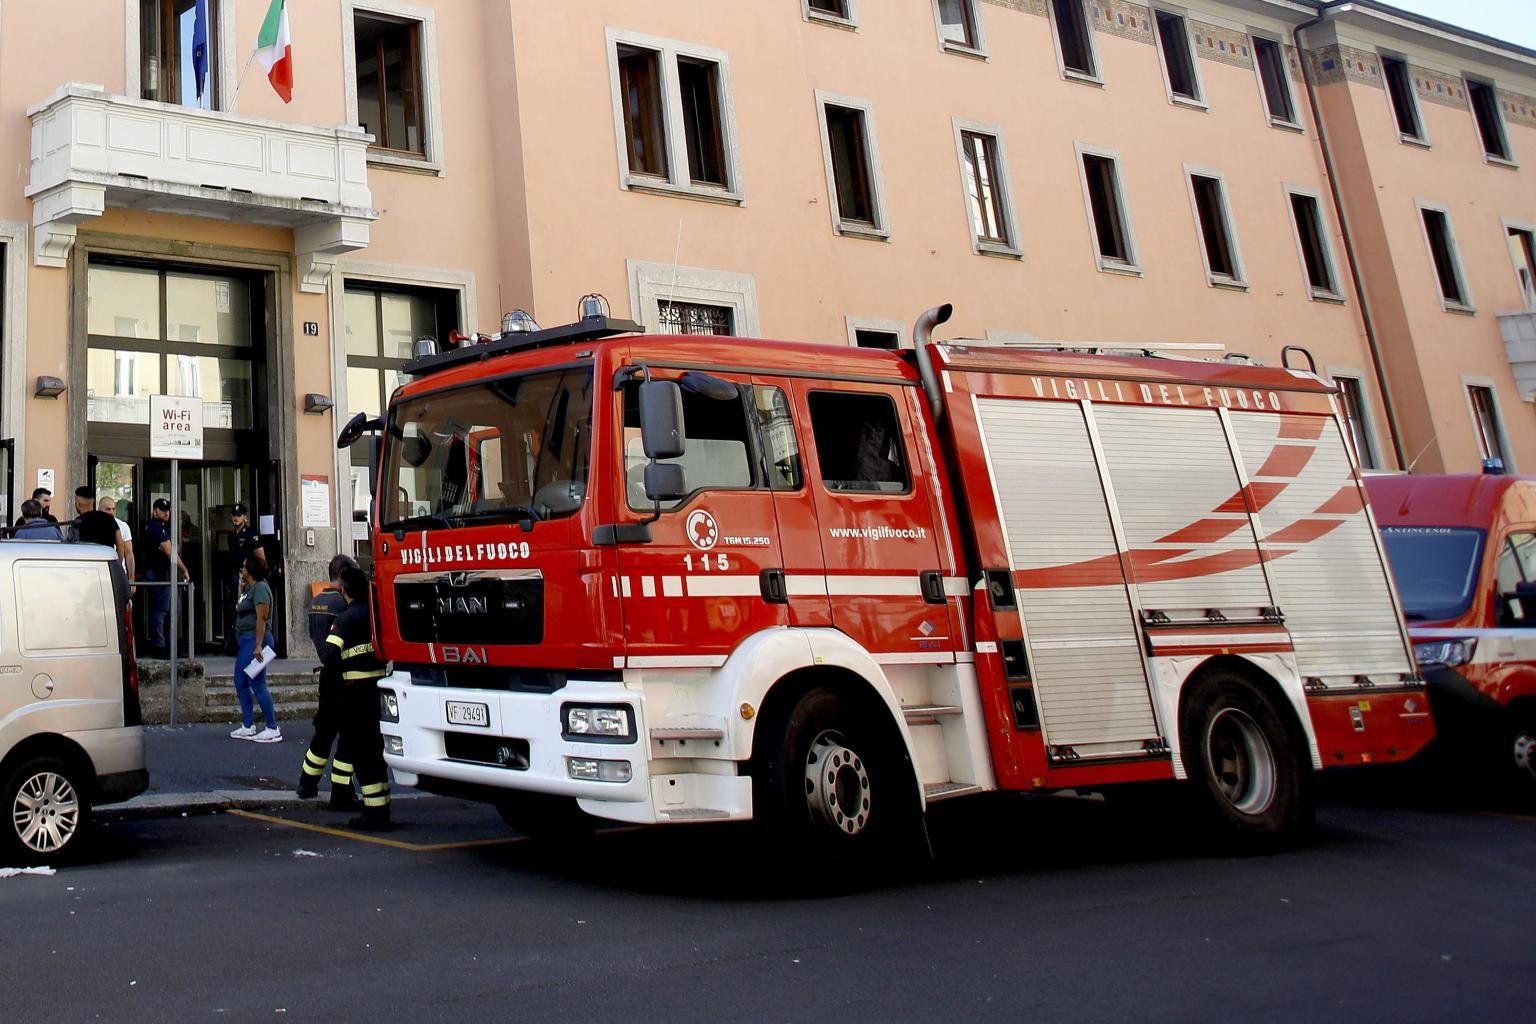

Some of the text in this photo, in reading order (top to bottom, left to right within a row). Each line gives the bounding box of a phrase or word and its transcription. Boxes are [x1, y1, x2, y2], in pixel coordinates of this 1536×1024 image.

[306, 322, 317, 335] 19
[1031, 377, 1281, 411] VIGILI DEL FUOCO
[162, 408, 191, 421] Wi-Fi
[162, 422, 191, 432] area
[829, 526, 927, 541] www.vigilfuoco.it
[400, 541, 531, 565] VIGILI DEL FUOCO
[437, 596, 488, 615] MAN
[442, 645, 489, 664] BAI
